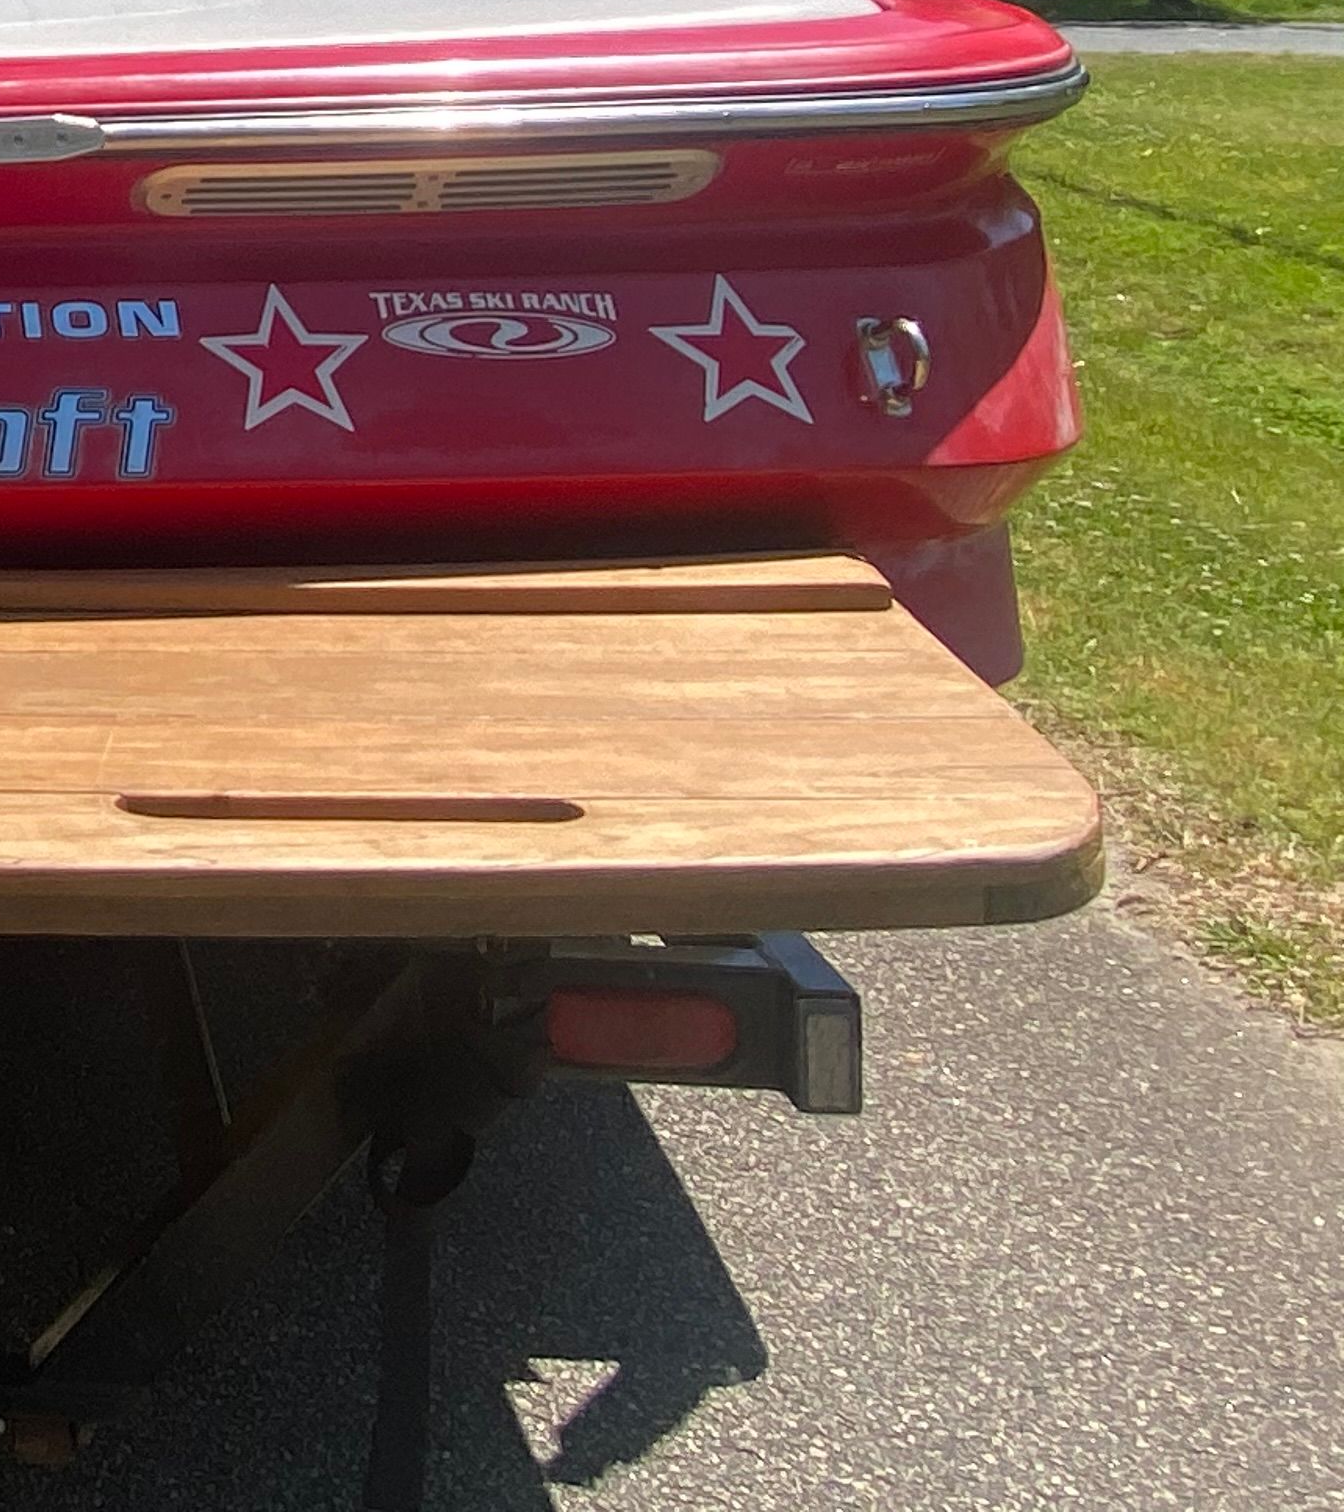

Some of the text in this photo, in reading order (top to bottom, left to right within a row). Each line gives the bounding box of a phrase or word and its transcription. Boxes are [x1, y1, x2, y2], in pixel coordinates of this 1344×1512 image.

[369, 291, 617, 320] TEXAS SKI RANCH
